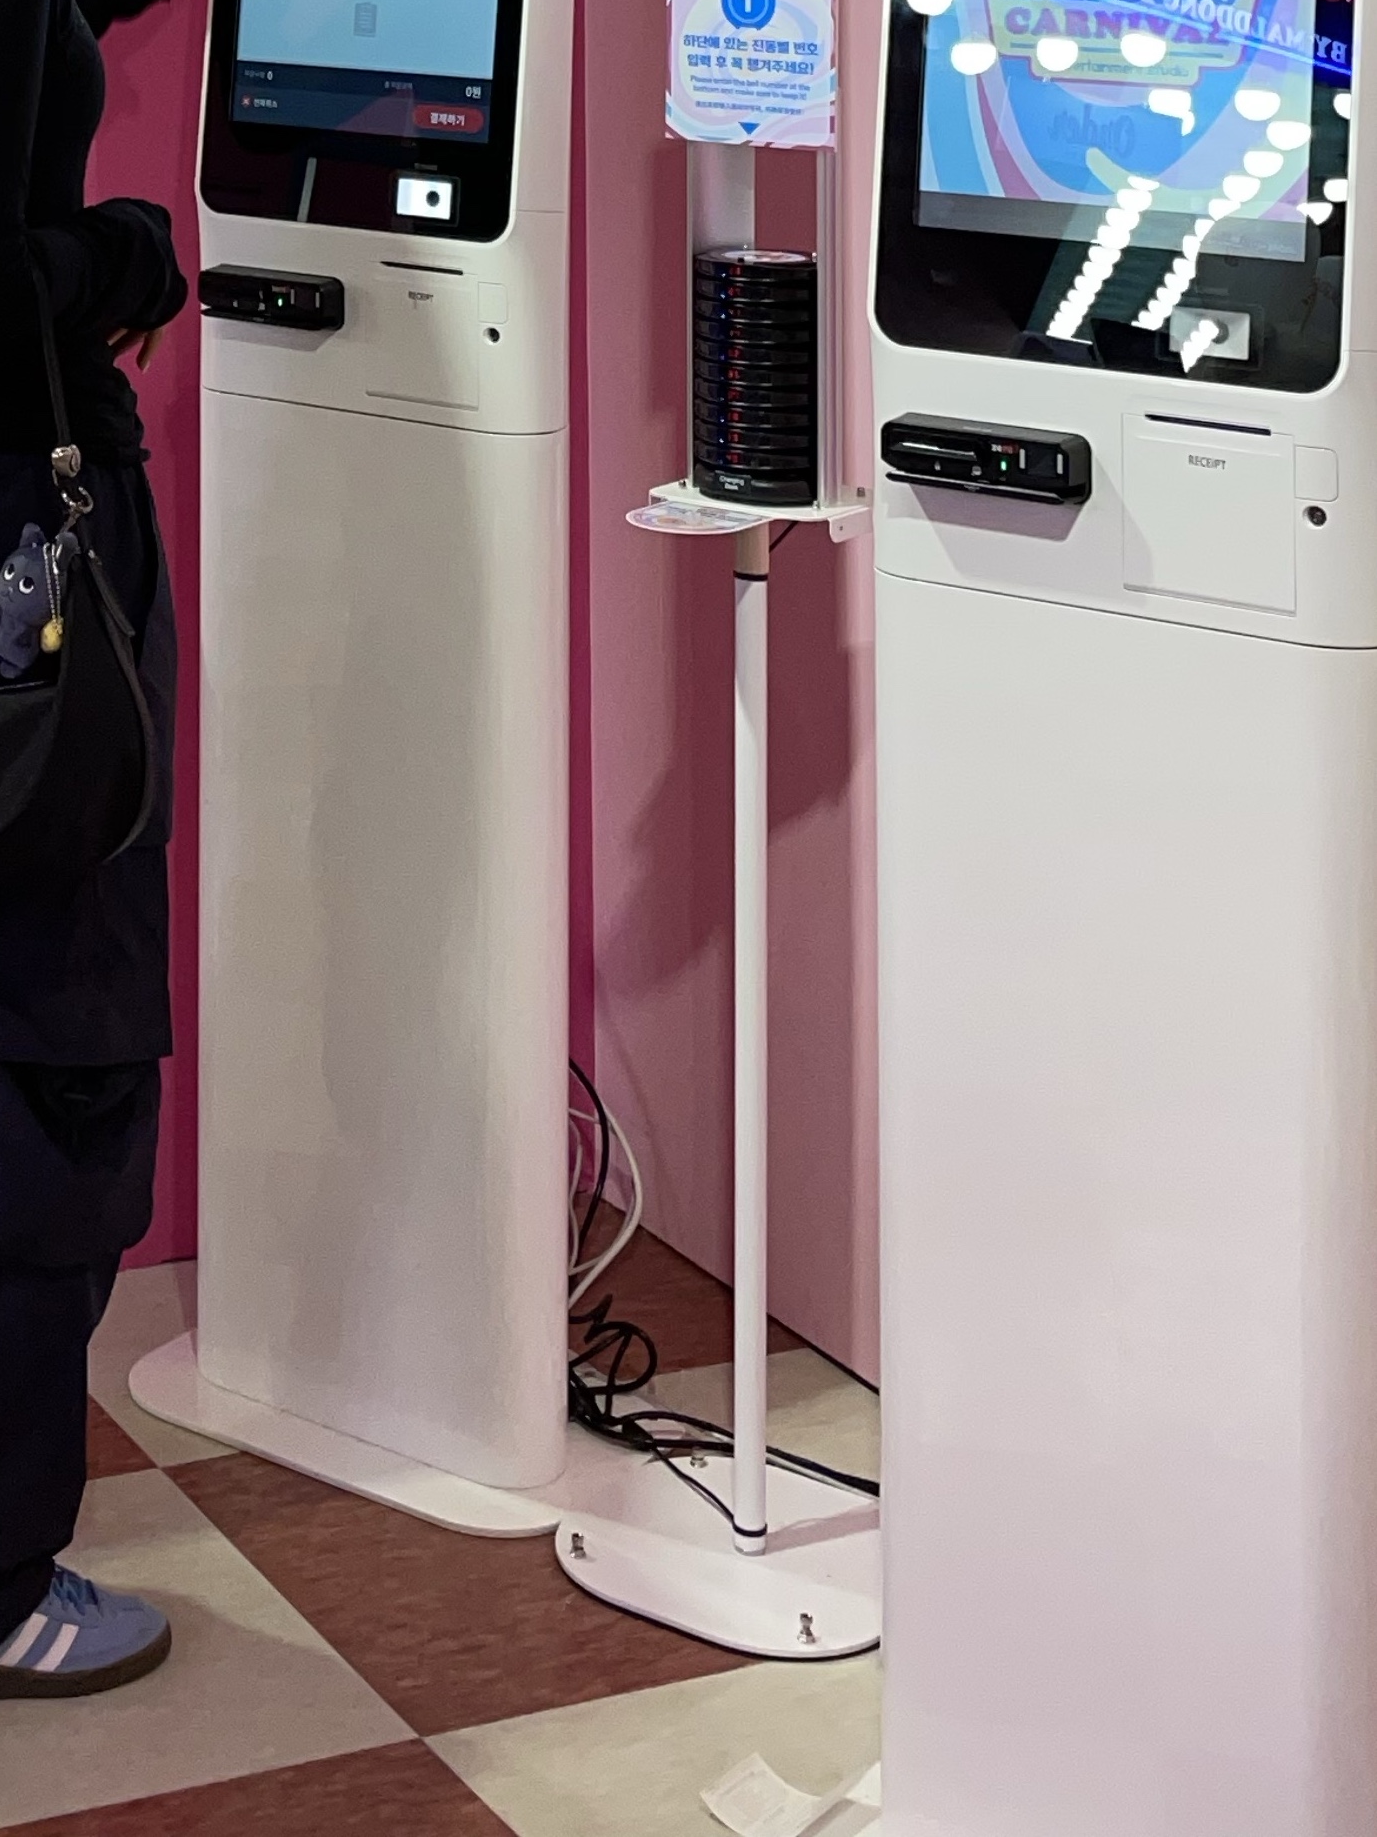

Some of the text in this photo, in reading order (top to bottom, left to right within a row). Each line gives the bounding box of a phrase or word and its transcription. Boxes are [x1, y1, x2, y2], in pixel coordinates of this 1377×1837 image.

[683, 34, 720, 49] 하단에
[723, 36, 749, 51] 있는
[793, 41, 819, 56] 번호
